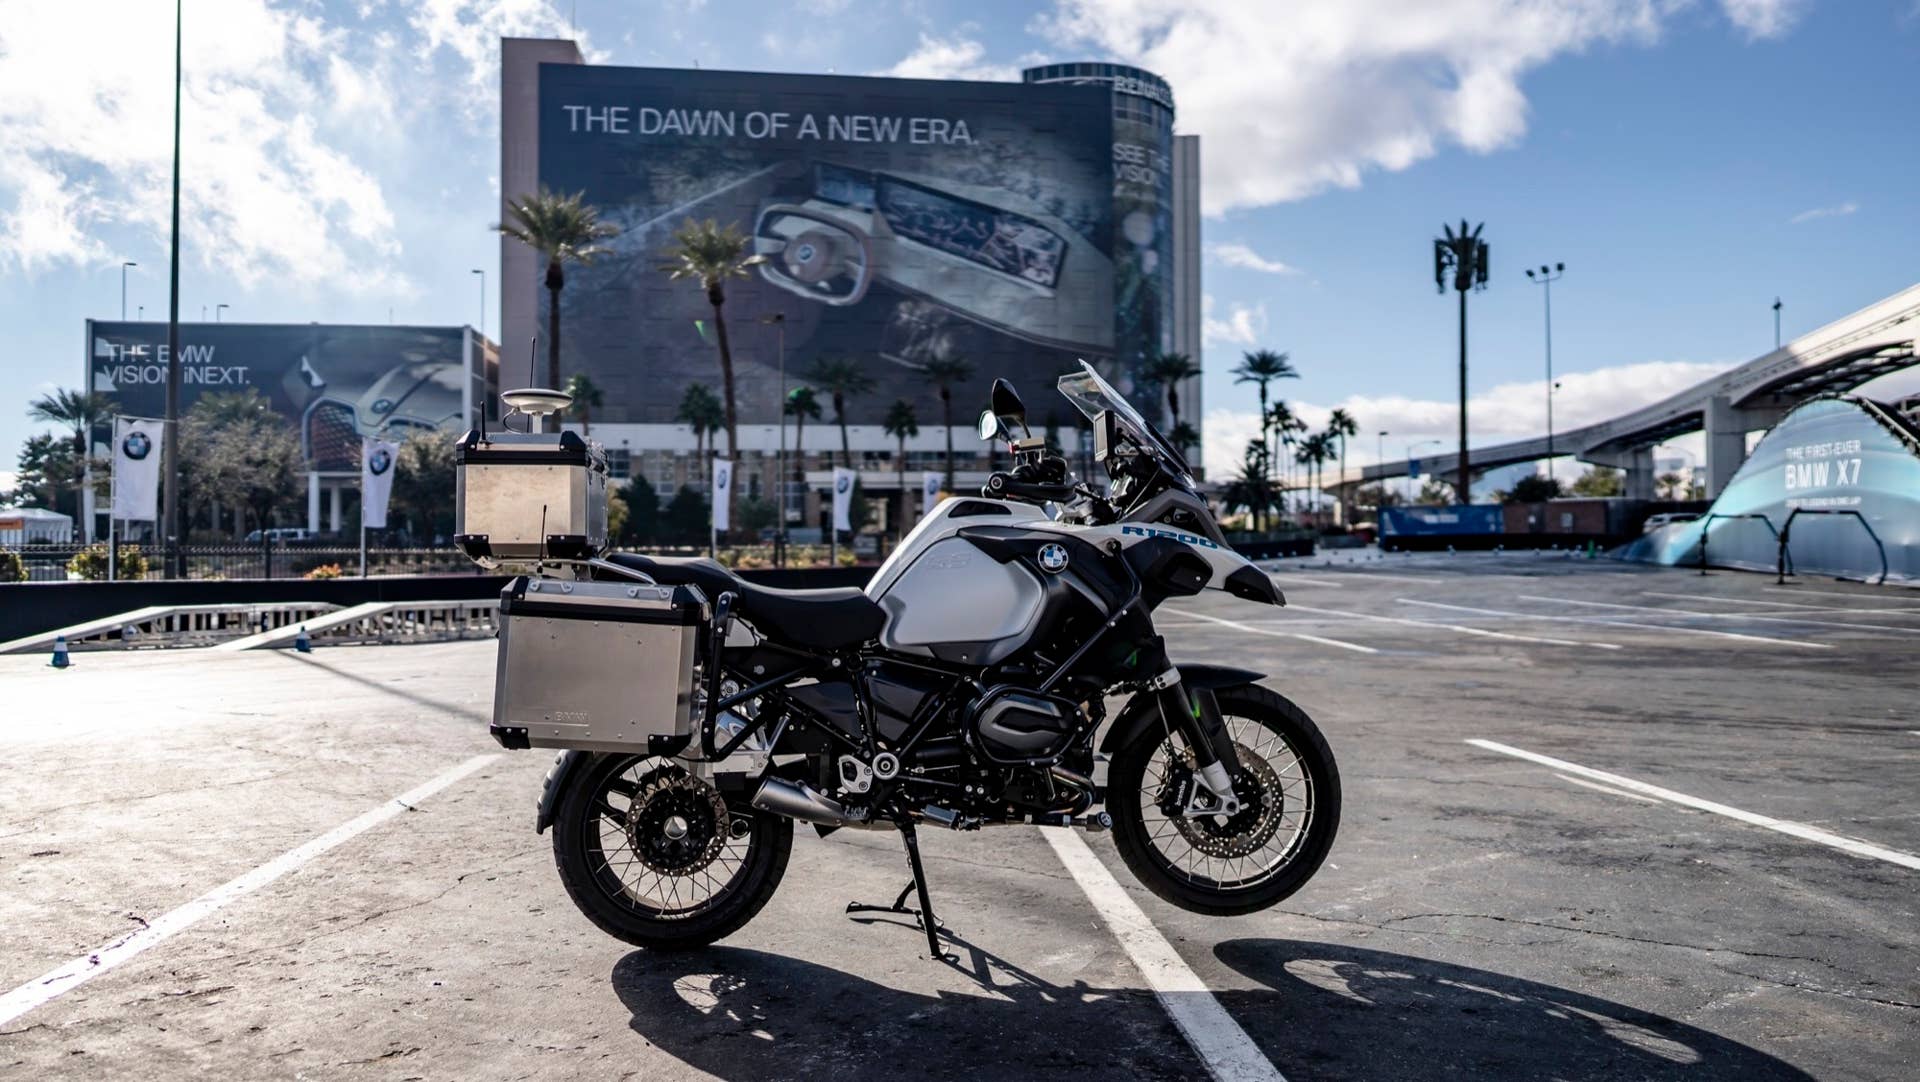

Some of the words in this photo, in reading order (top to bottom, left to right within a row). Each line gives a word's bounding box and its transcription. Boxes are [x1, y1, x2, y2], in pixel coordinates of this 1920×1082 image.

[562, 105, 630, 134] THE
[639, 107, 735, 137] DAWN
[743, 111, 790, 139] OF
[796, 114, 821, 140] A
[827, 114, 902, 143] NEW
[909, 117, 979, 145] ERA.
[1113, 143, 1145, 164] SEE
[183, 366, 250, 385] iNEXT.
[1784, 447, 1804, 460] THE
[1785, 461, 1830, 490] BMW
[1836, 458, 1861, 487] X7
